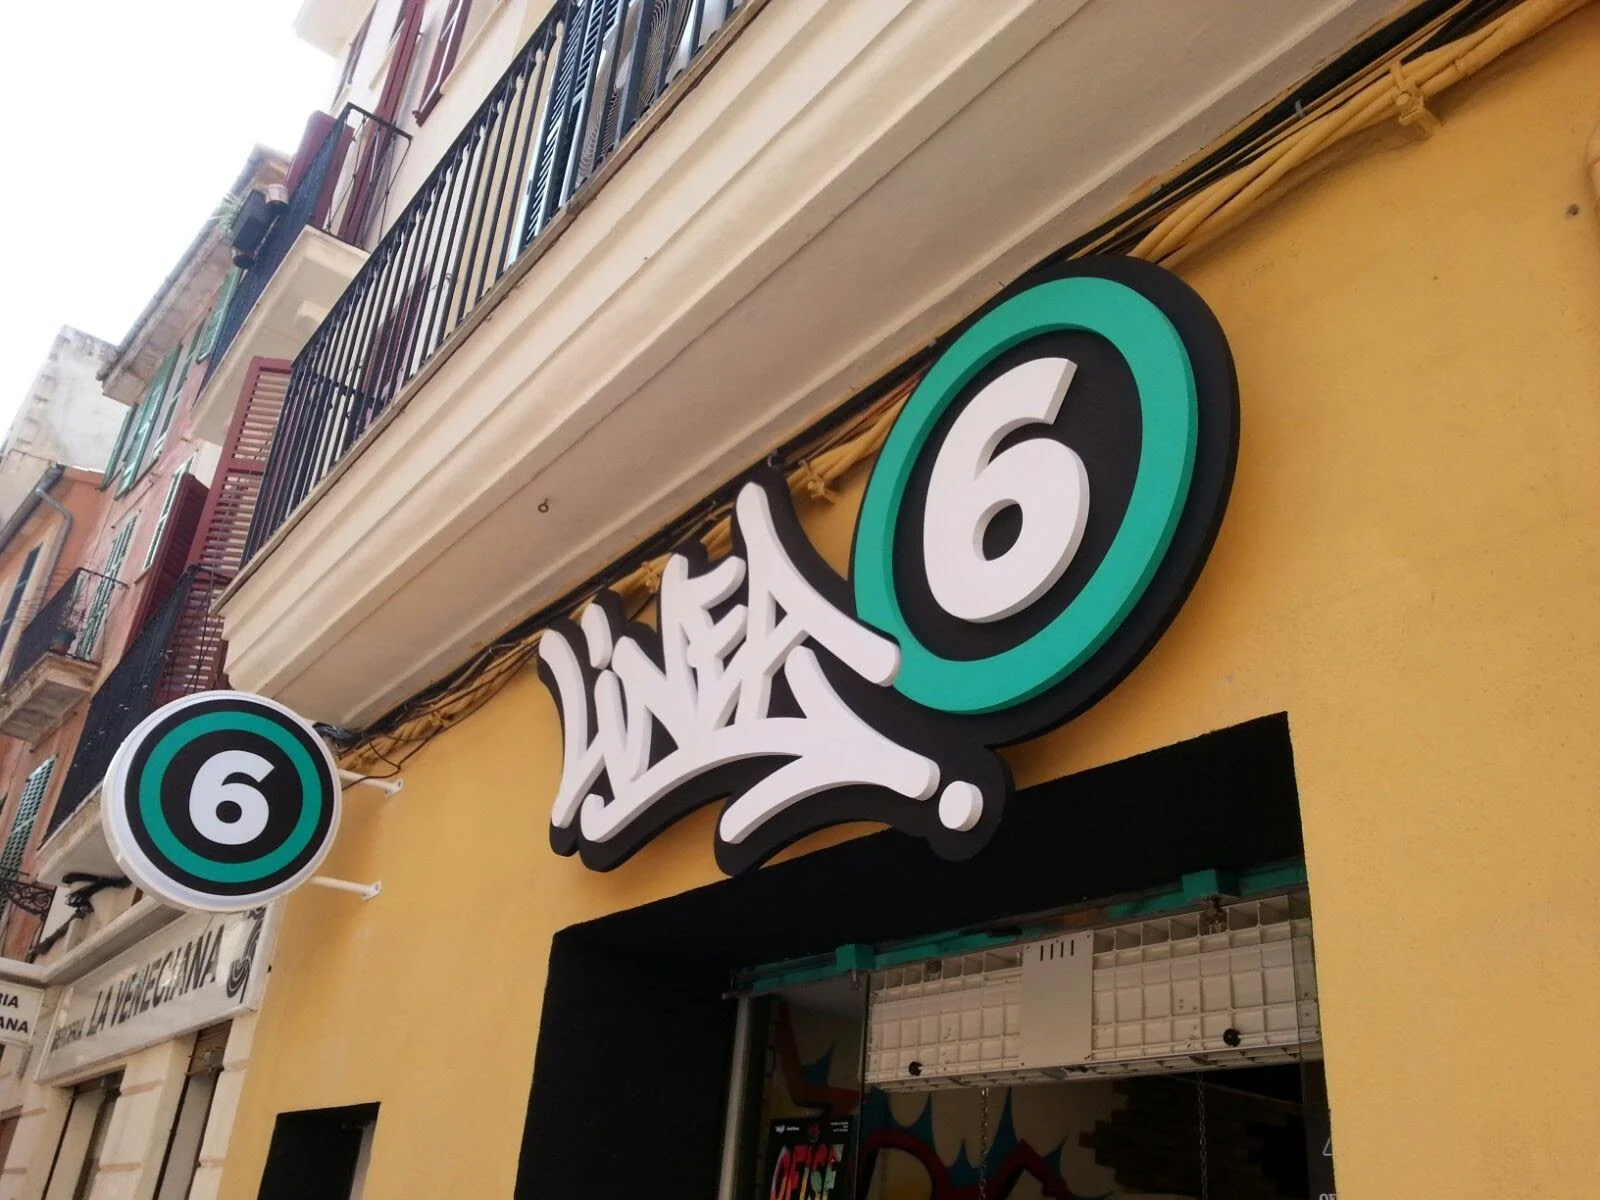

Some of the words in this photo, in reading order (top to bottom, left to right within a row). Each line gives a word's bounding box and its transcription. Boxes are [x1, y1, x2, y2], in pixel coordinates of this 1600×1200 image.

[922, 357, 1089, 624] 6
[188, 749, 276, 846] 6
[86, 990, 112, 1035] LA
[110, 924, 225, 1028] VENECIANA
